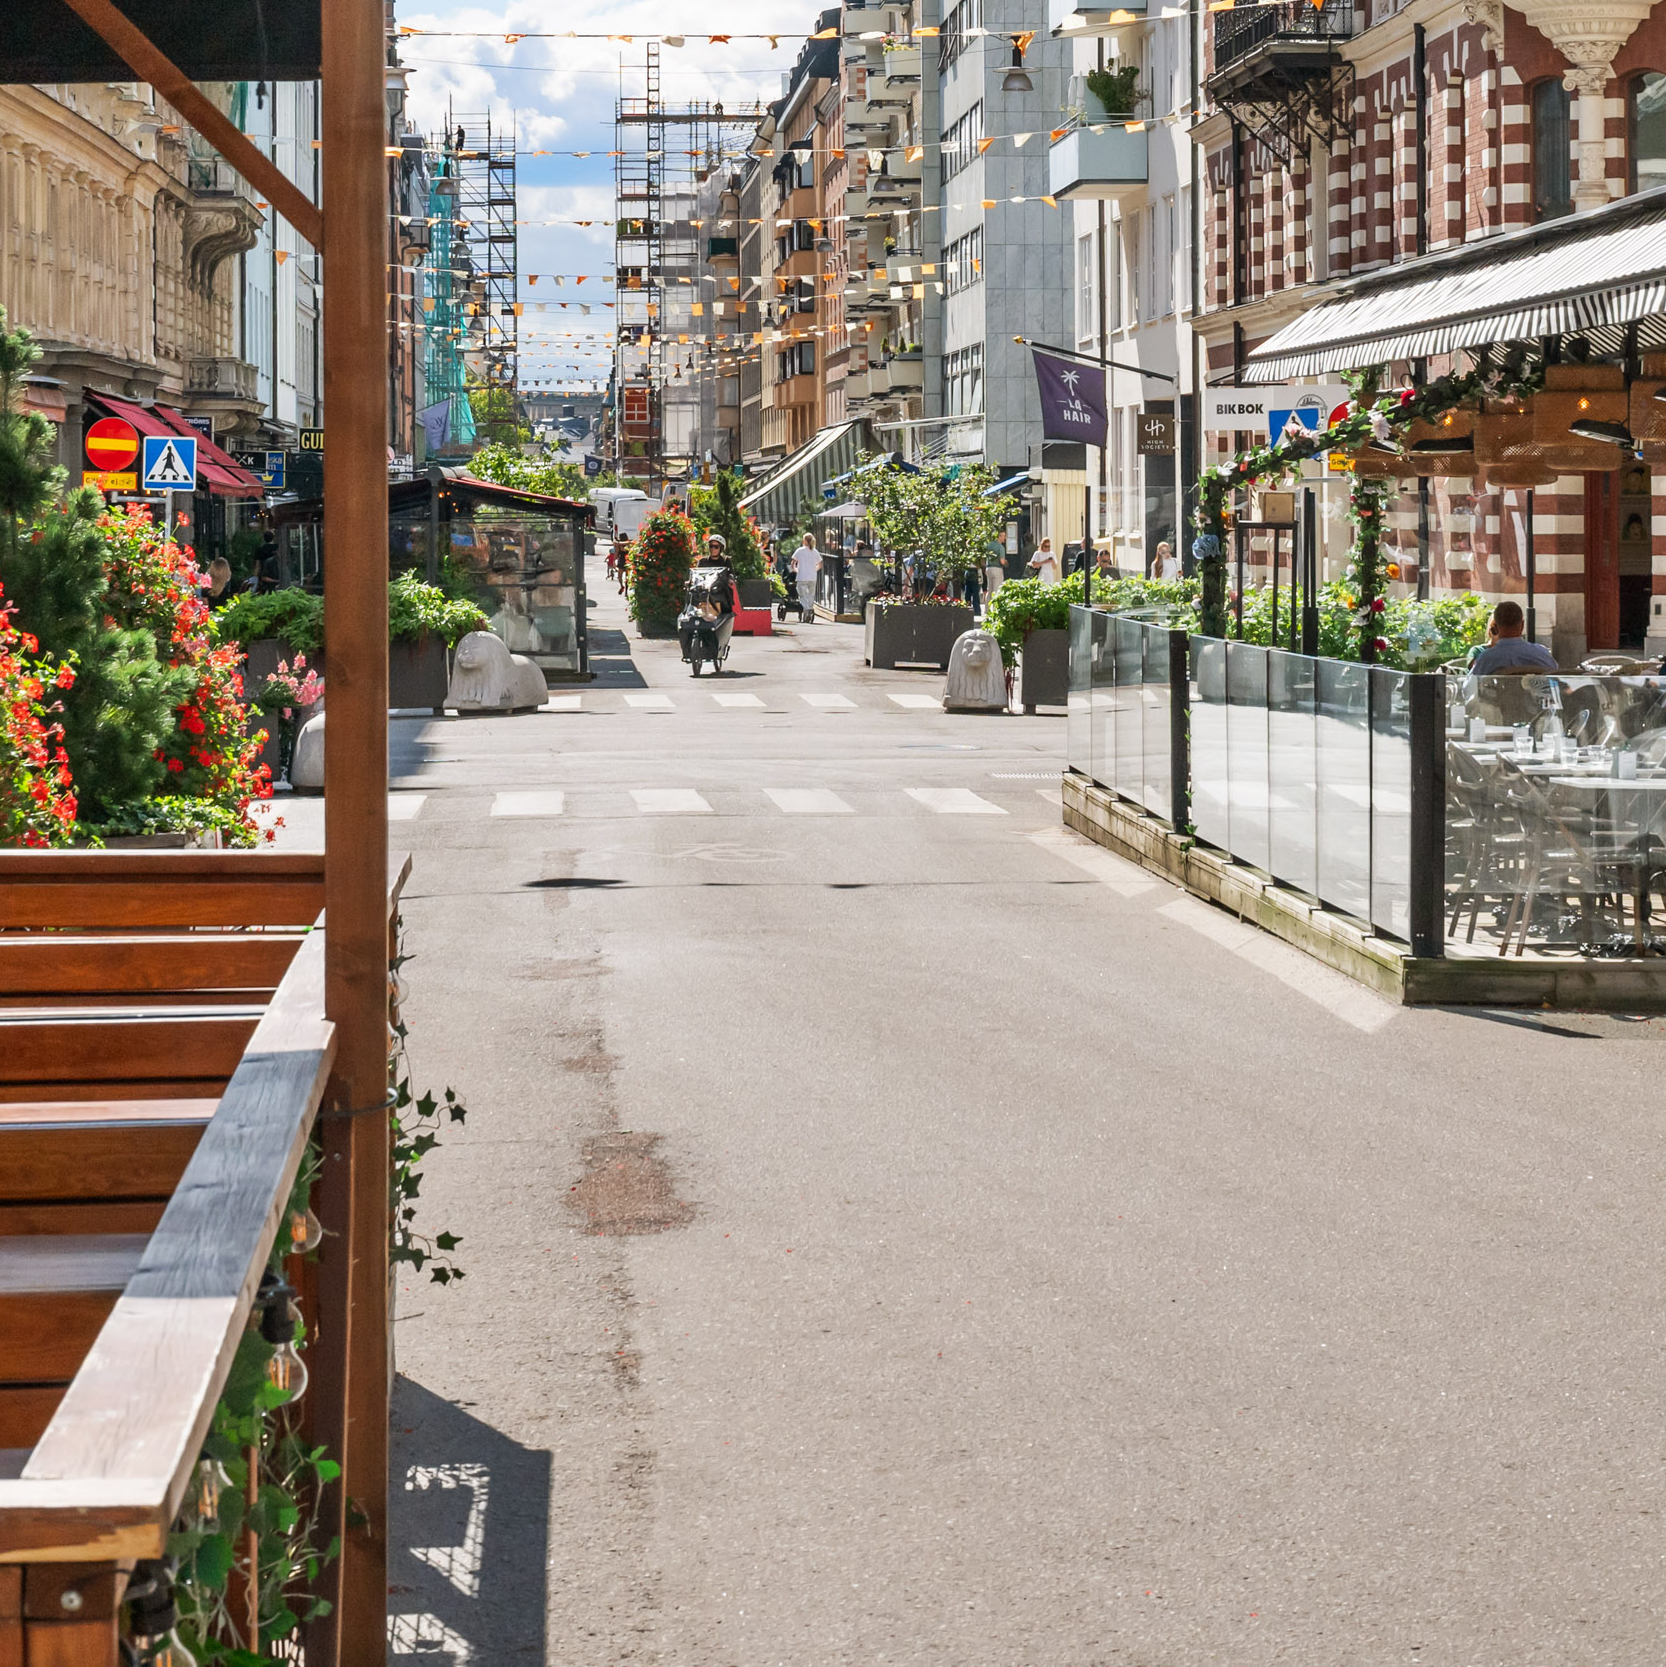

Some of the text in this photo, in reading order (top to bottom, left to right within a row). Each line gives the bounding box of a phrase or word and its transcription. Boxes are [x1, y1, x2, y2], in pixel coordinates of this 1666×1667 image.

[1068, 398, 1082, 411] LA
[1216, 403, 1264, 415] BIK BOK
[1063, 410, 1091, 424] HAIR
